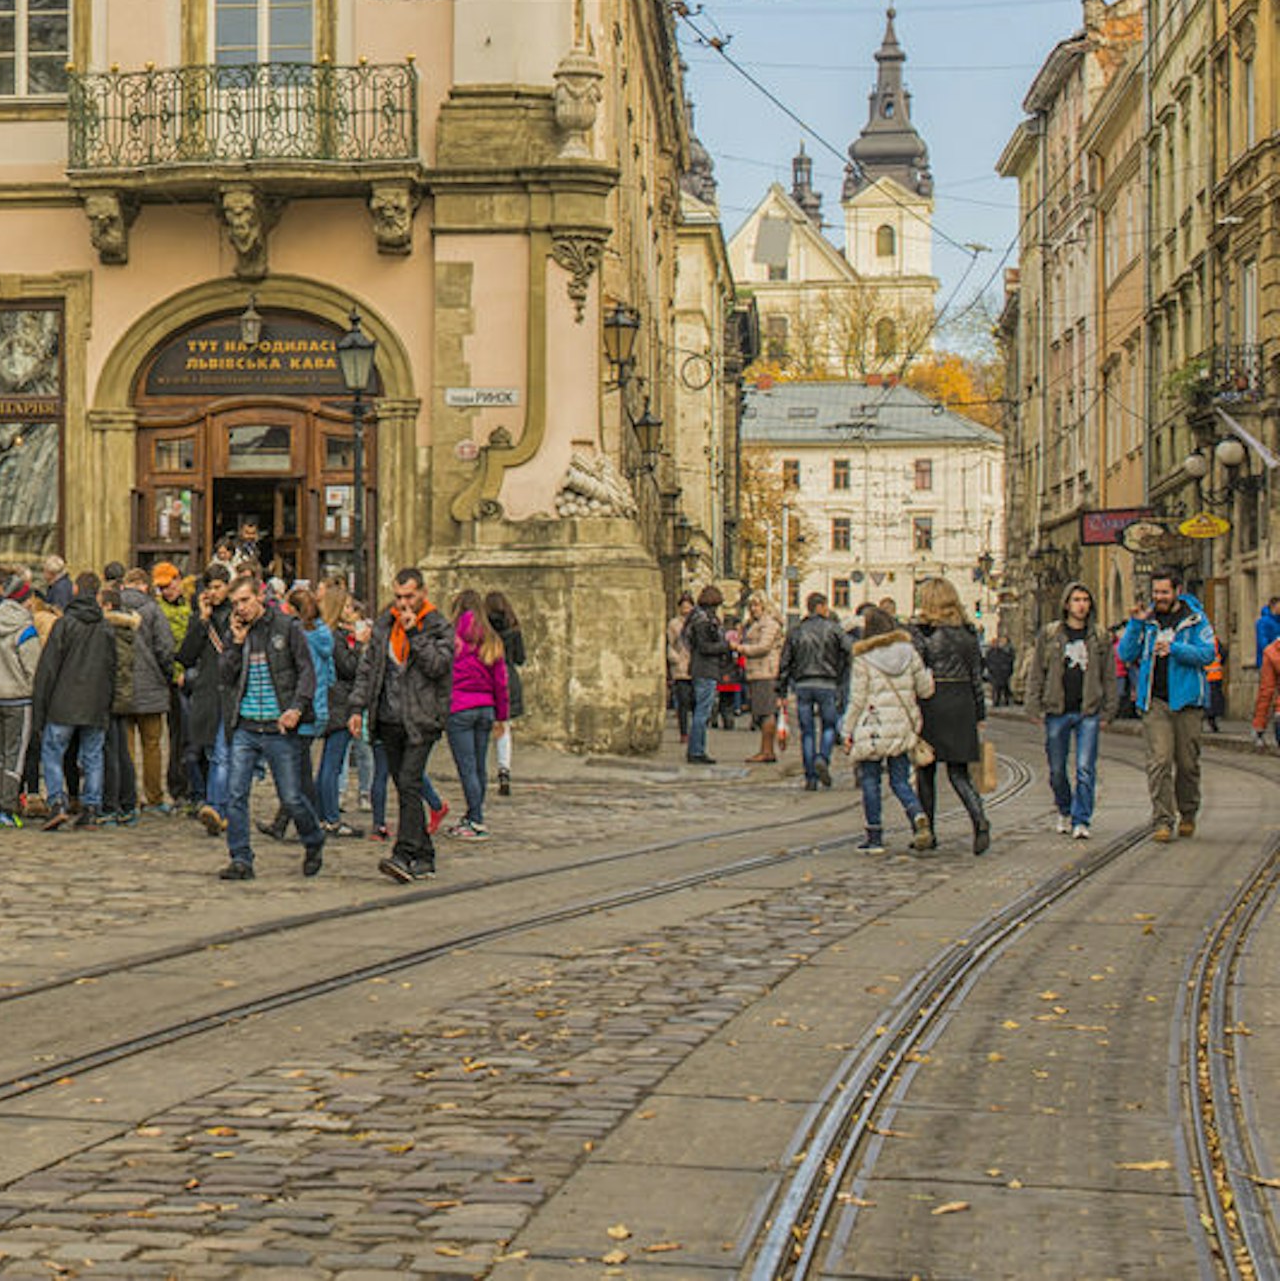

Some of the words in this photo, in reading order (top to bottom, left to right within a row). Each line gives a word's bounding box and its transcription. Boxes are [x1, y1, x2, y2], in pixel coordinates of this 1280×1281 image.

[186, 339, 219, 353] ТУТ
[224, 339, 337, 354] НАОДИЛАСЬ
[185, 357, 282, 371] ЛЬВІВСЬКА
[290, 357, 337, 371] КАВА
